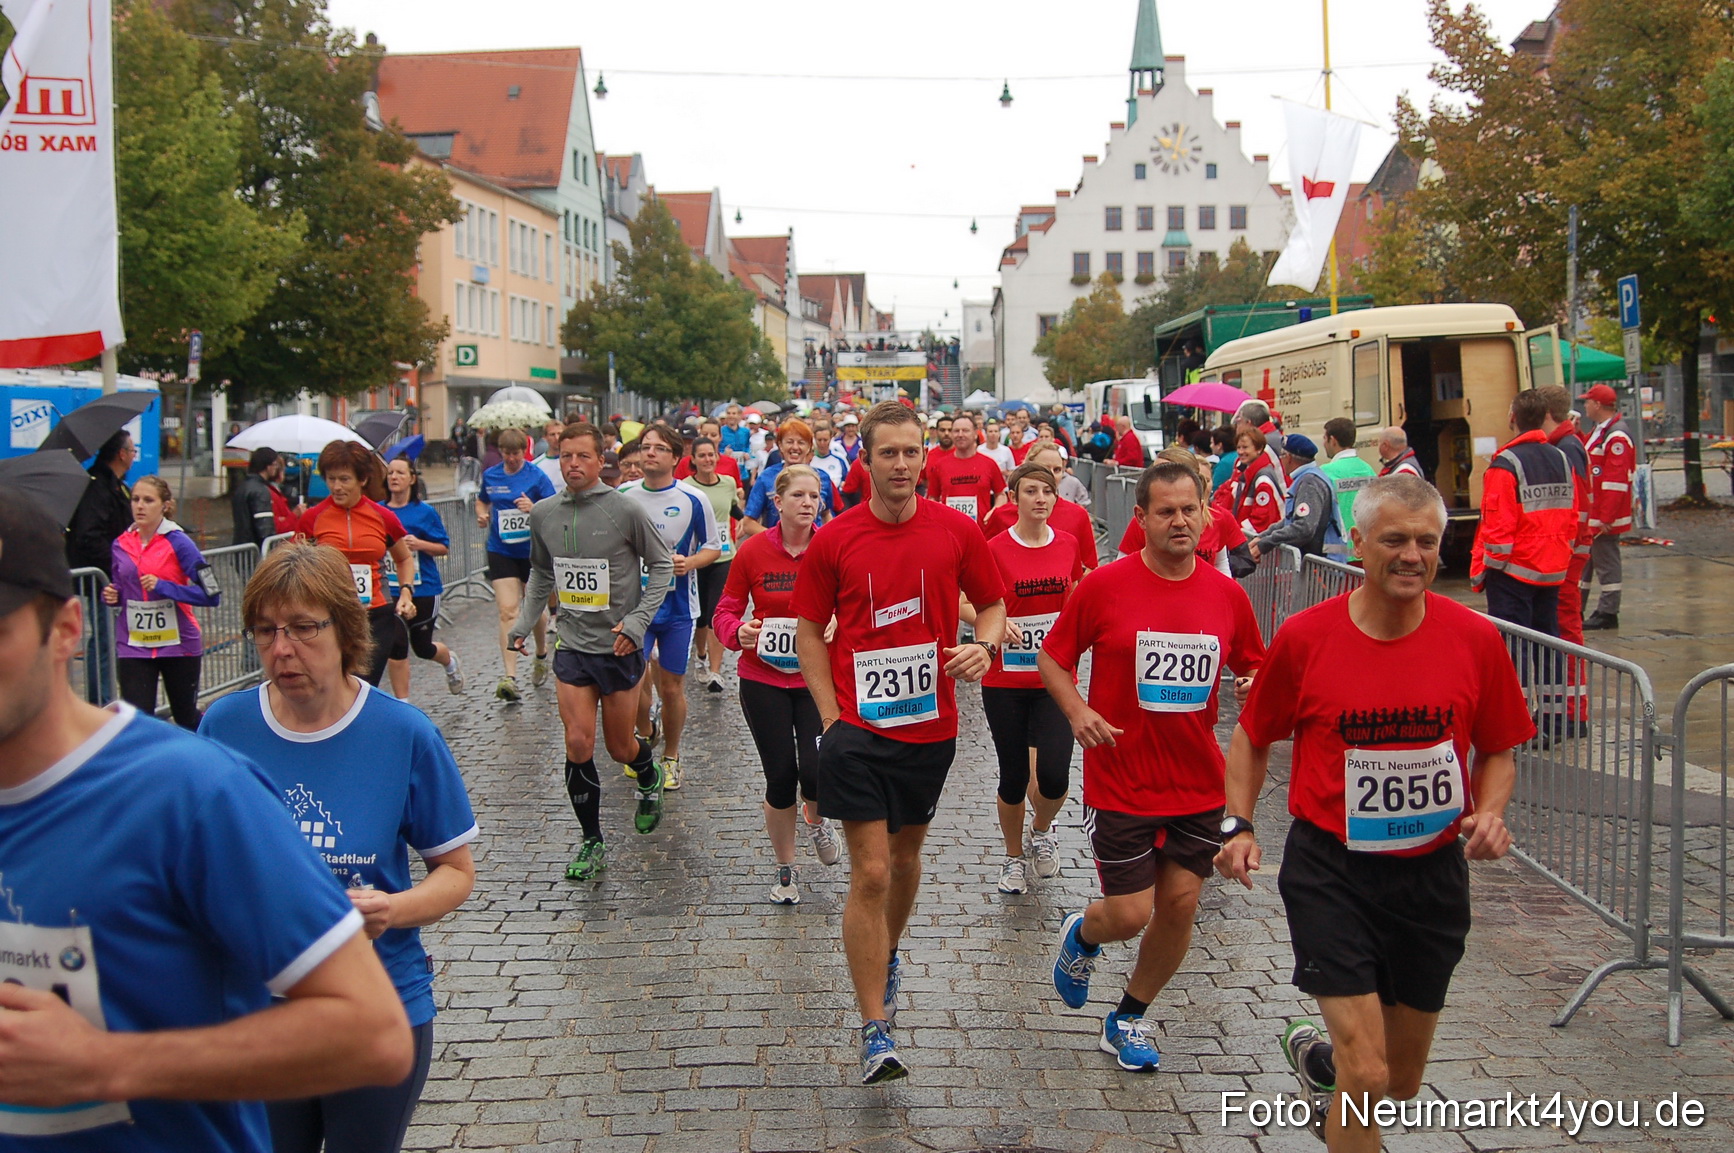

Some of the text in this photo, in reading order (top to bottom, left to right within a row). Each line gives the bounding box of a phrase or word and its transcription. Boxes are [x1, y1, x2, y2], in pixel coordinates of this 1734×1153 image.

[1622, 283, 1634, 323] P
[458, 347, 477, 364] D
[1280, 359, 1327, 385] Bayerisches
[12, 406, 49, 428] DIXI
[1523, 485, 1573, 499] NOTARZT
[565, 571, 598, 591] 265
[571, 594, 594, 604] Daniel
[135, 611, 166, 630] 276
[888, 606, 908, 619] DEHN
[1023, 619, 1052, 628] Neumarkt
[1138, 639, 1207, 651] PARTL Neumarkt
[856, 653, 925, 668] PARTL Neumarkt
[1020, 655, 1036, 665] Nad
[1145, 651, 1212, 683] 2280
[865, 663, 932, 700] 2316
[1160, 688, 1193, 701] Stefan
[877, 701, 923, 717] Christian
[1345, 727, 1371, 741] RUN
[1374, 723, 1397, 741] FOR
[1347, 757, 1442, 771] PARTL Neumarkt
[1357, 769, 1453, 813] 2656
[1387, 820, 1425, 836] Erich
[320, 853, 376, 865] Stadtlauf
[332, 867, 349, 875] 012
[0, 949, 51, 969] markt
